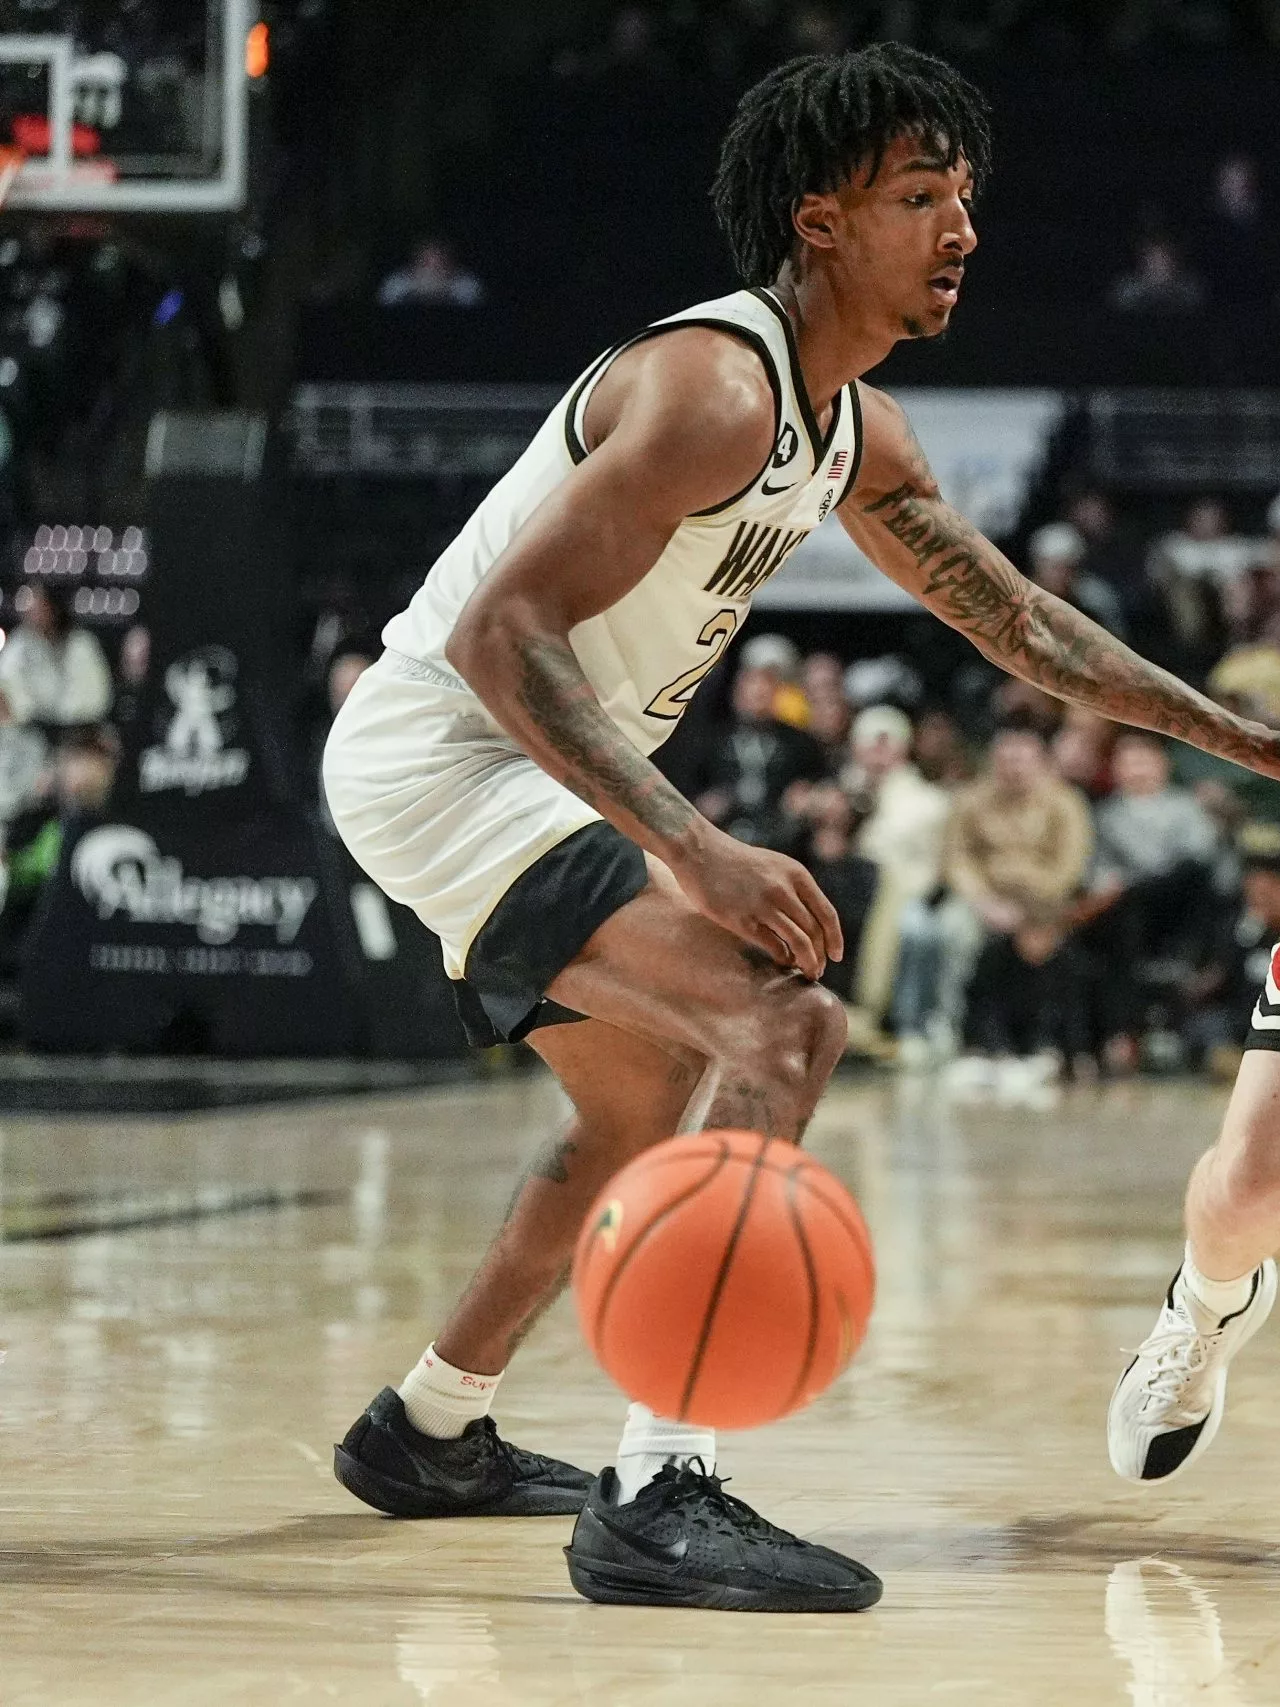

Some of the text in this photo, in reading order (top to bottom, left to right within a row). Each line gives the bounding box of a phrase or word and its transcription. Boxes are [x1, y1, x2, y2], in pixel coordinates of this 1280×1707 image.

[777, 430, 794, 462] 4
[702, 519, 811, 597] WAK
[643, 608, 737, 720] 2
